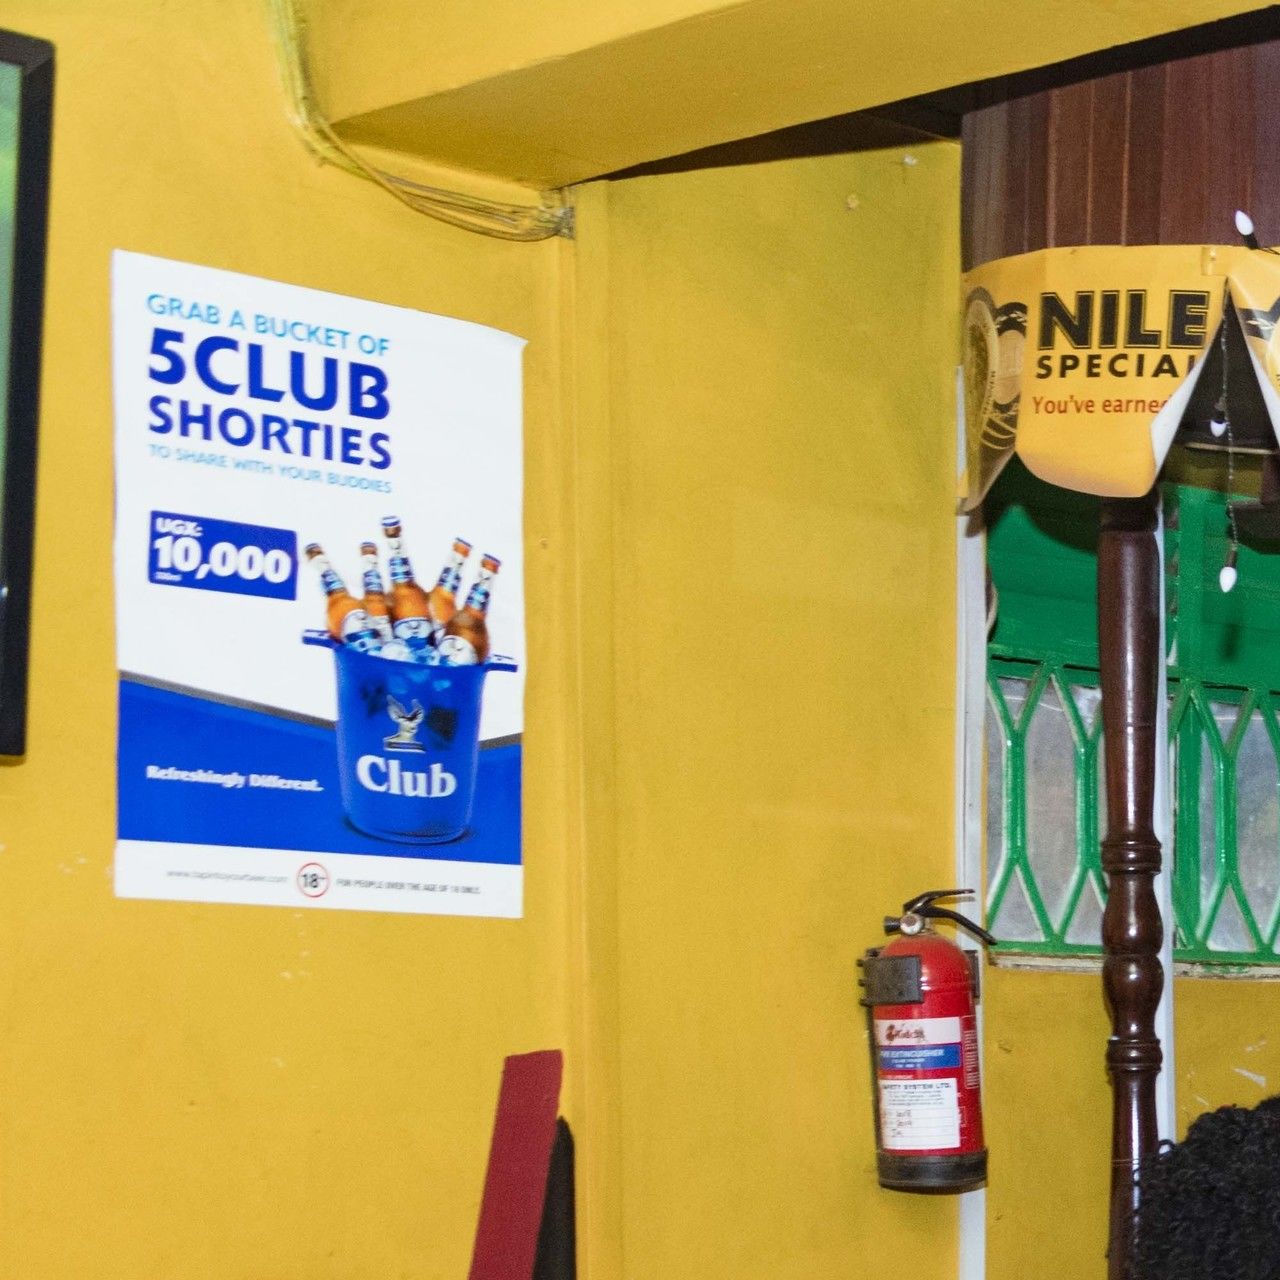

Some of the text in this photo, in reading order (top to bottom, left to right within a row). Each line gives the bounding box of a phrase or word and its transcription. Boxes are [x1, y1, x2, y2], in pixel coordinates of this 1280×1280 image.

[147, 293, 390, 356] GRAB A BUCKET OF
[1038, 290, 1210, 350] NILE
[1033, 396, 1094, 414] You've
[148, 395, 392, 470] SHORTIES
[149, 444, 392, 494] TO SHARE WITH YOUR BUDDIES
[154, 536, 292, 583] 10,000
[357, 755, 456, 797] Club
